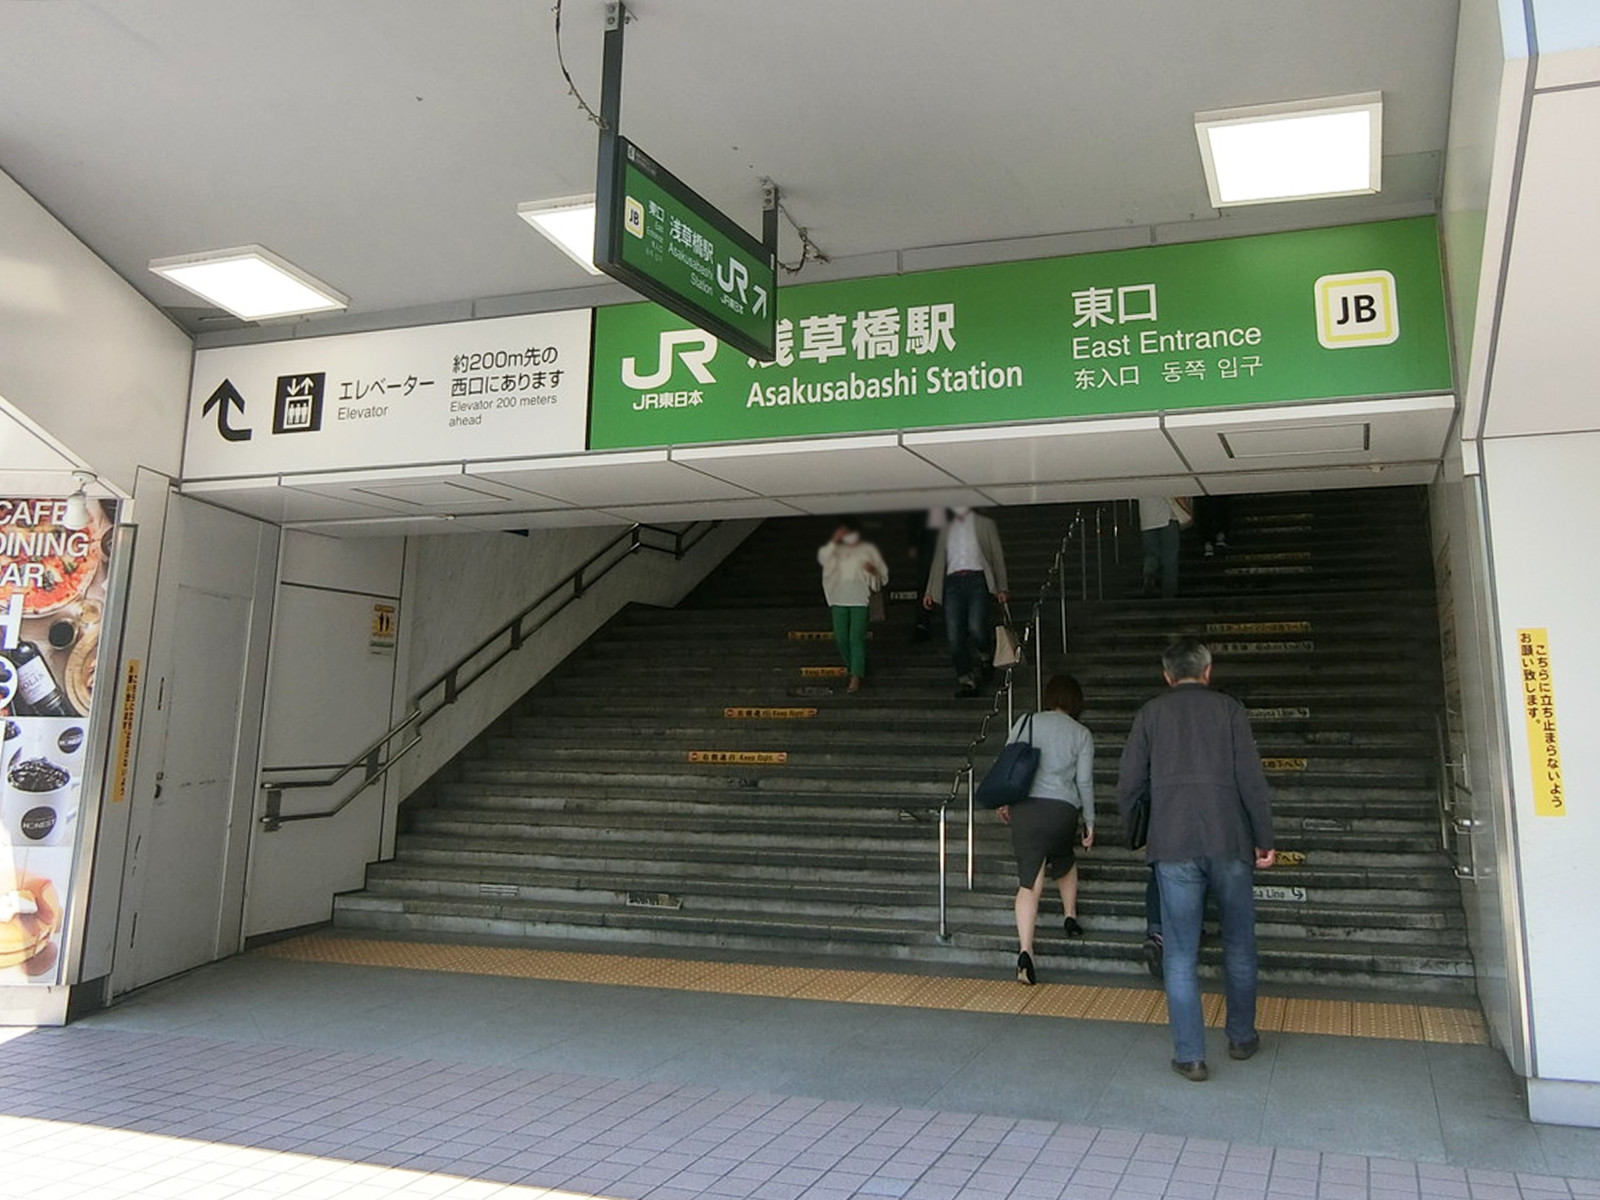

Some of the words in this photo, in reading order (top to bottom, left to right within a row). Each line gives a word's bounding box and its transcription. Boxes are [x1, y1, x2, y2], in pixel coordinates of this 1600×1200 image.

[629, 208, 640, 226] JB
[670, 215, 714, 265] 浅草橋駅
[690, 272, 714, 297] Station
[717, 256, 748, 305] JR
[1071, 283, 1158, 328] 東口
[1336, 294, 1377, 325] JB
[1073, 334, 1131, 360] East
[1140, 327, 1262, 354] Entrance
[452, 346, 559, 374] 約200m先の
[621, 328, 718, 390] JR
[1161, 360, 1206, 383] 동쪽
[1217, 355, 1263, 380] 입구
[339, 375, 435, 401] エレベーター
[450, 369, 565, 397] 西口にあります
[746, 368, 918, 409] Asakusabashi
[926, 361, 1023, 394] Station
[1074, 366, 1140, 391] 东入口
[337, 404, 389, 420] Elevator
[450, 399, 494, 413] Elevator
[496, 397, 517, 409] 200
[519, 394, 558, 407] meters
[632, 390, 704, 411] JR東日本
[449, 413, 482, 428] ahead
[1520, 633, 1541, 725] お願い致します。
[1536, 644, 1563, 808] こちらに立ち止まらないよう
